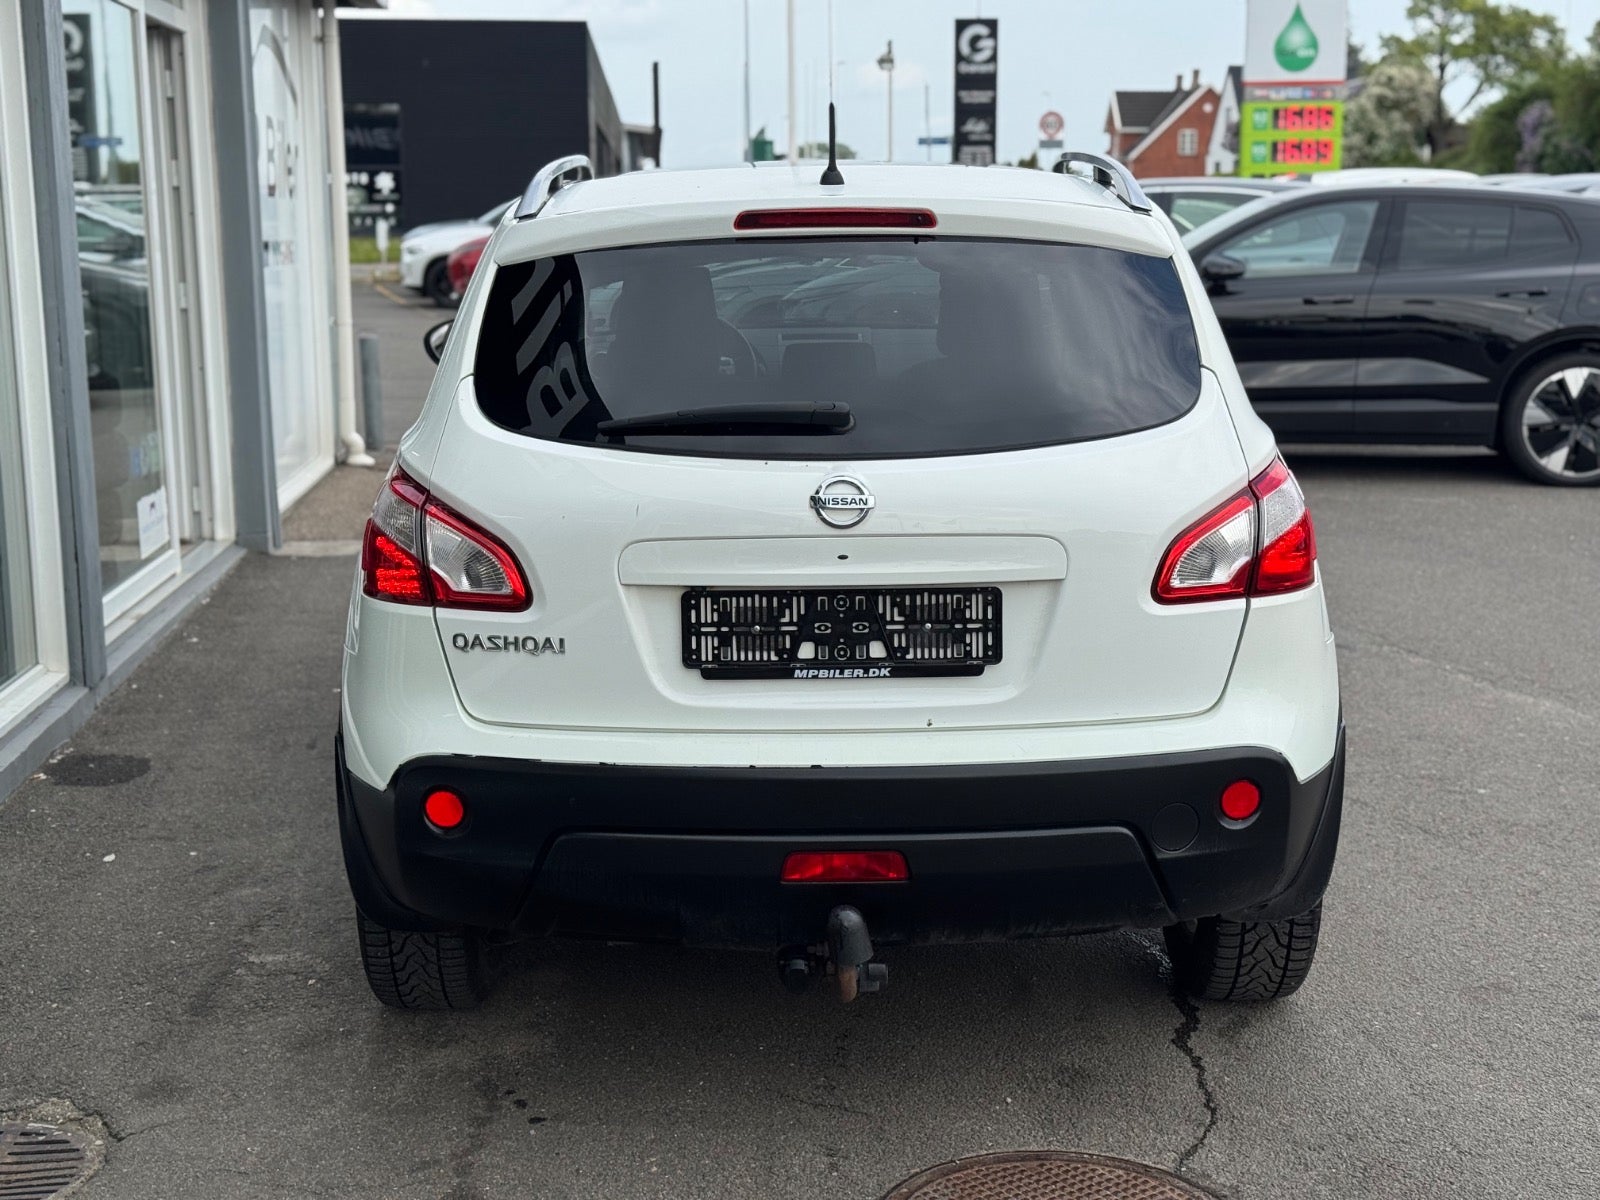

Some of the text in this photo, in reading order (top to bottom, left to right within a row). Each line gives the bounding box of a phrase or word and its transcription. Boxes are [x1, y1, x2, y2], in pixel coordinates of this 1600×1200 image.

[817, 497, 868, 506] NISSAN
[452, 632, 566, 656] QASHQAI
[793, 667, 892, 679] MPBILER.DK
